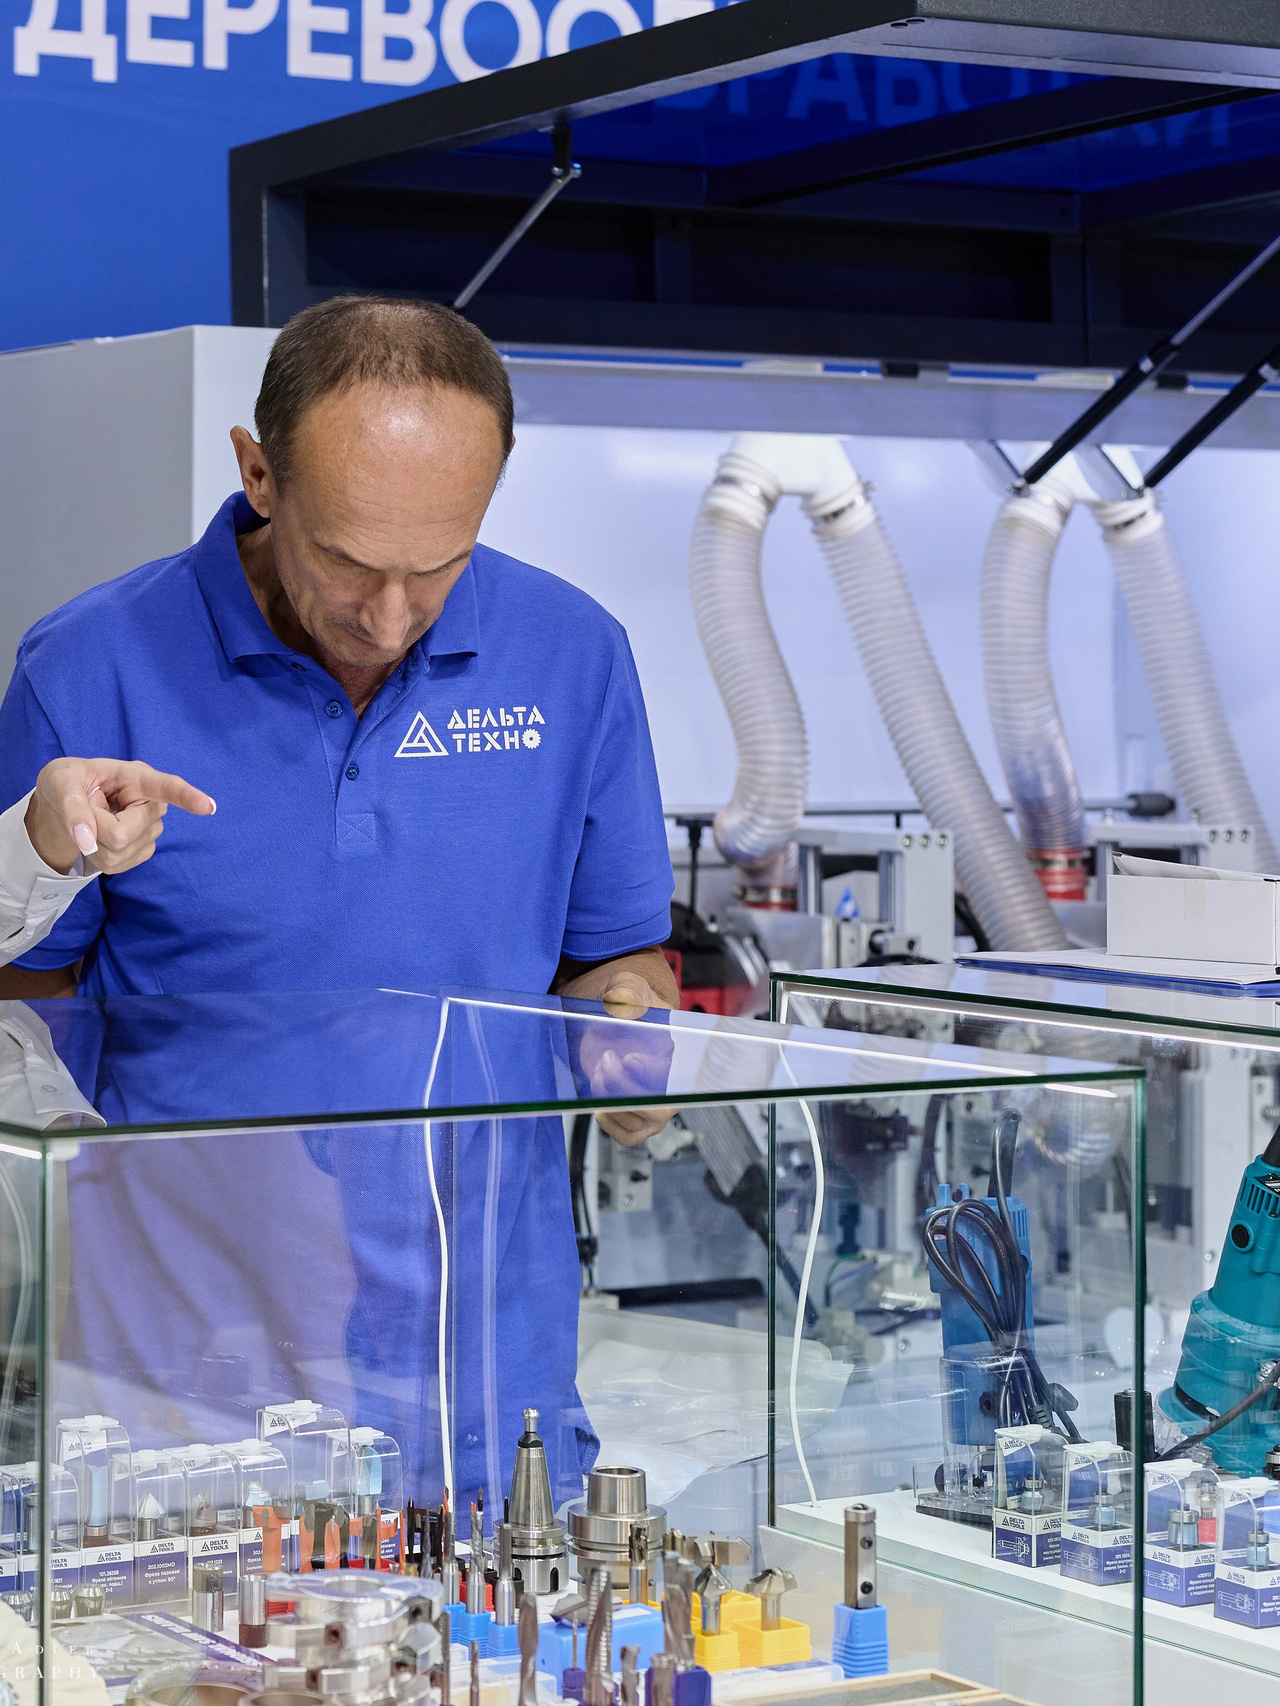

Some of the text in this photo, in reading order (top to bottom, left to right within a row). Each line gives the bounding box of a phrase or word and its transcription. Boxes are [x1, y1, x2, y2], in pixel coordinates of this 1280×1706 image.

[447, 704, 546, 730] ДЕЛЬТА
[452, 727, 542, 753] ТЕХНО
[1009, 1517, 1025, 1525] DELTA
[1009, 1521, 1025, 1530] TOOLS
[144, 1571, 160, 1579] Фреза
